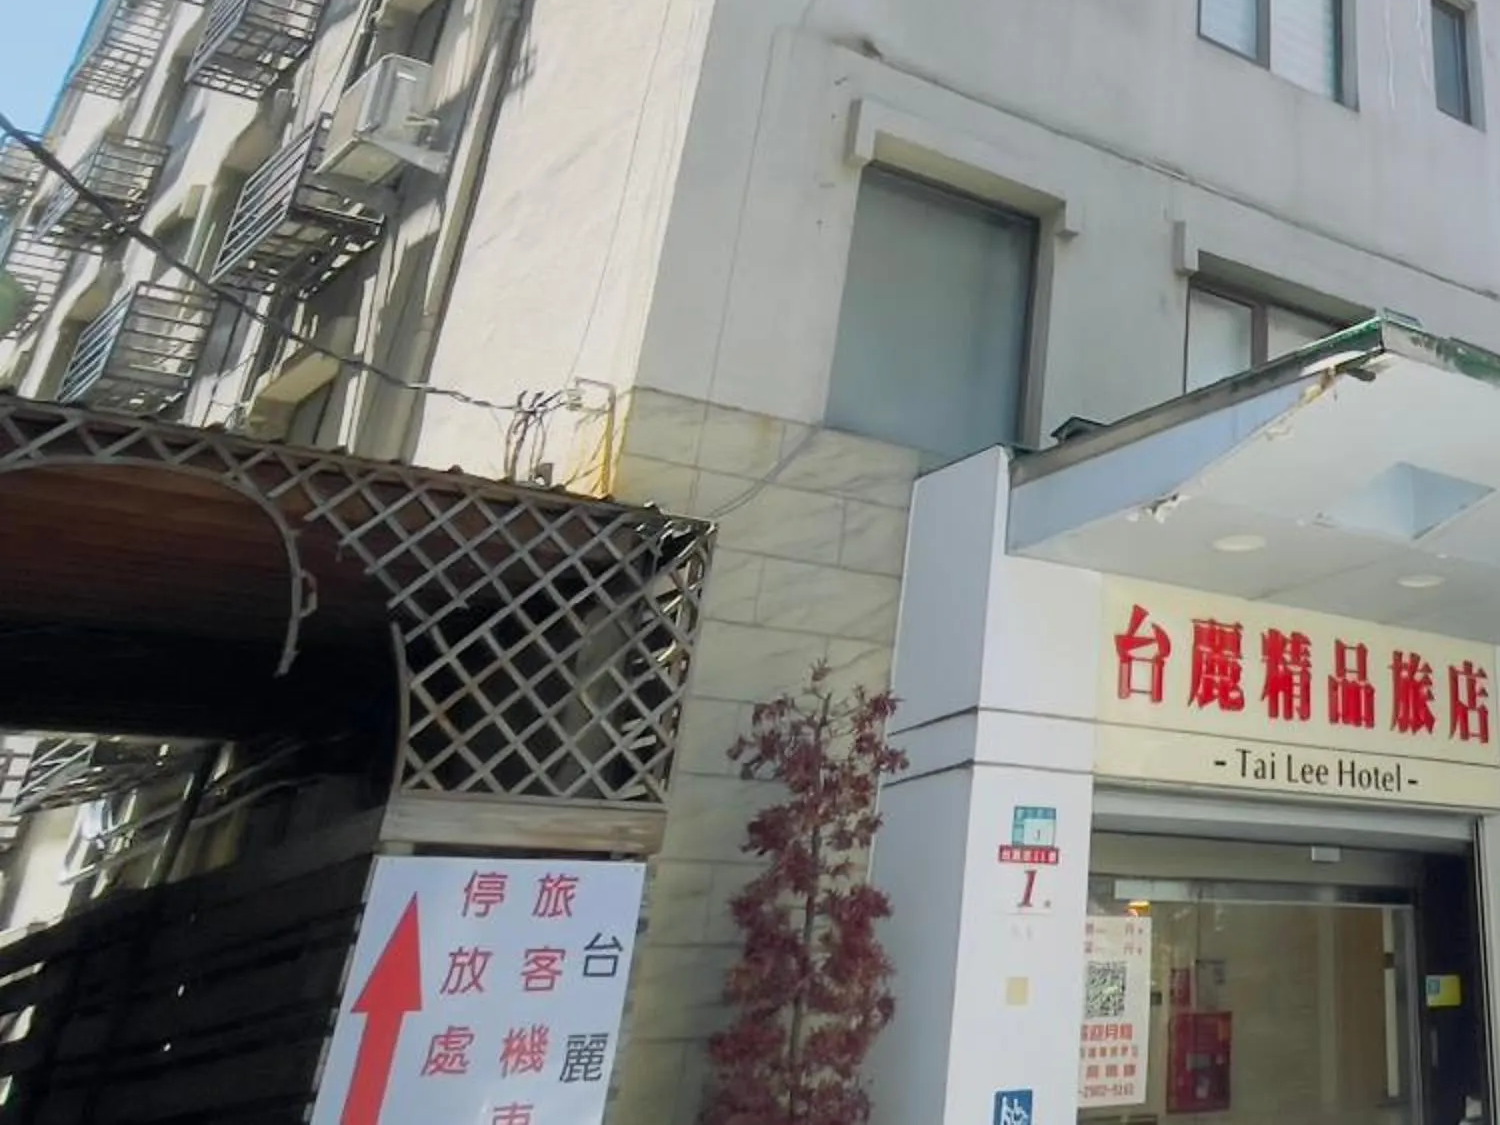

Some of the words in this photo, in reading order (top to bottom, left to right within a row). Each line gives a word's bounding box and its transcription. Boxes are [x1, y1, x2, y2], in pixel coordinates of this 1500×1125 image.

[1113, 603, 1491, 745] 台麗精品旅店
[1235, 748, 1277, 781] Tai
[1286, 754, 1329, 786] Lee
[1338, 759, 1402, 793] Hotel
[420, 869, 510, 1078] 停放處
[558, 931, 625, 1083] 台麗
